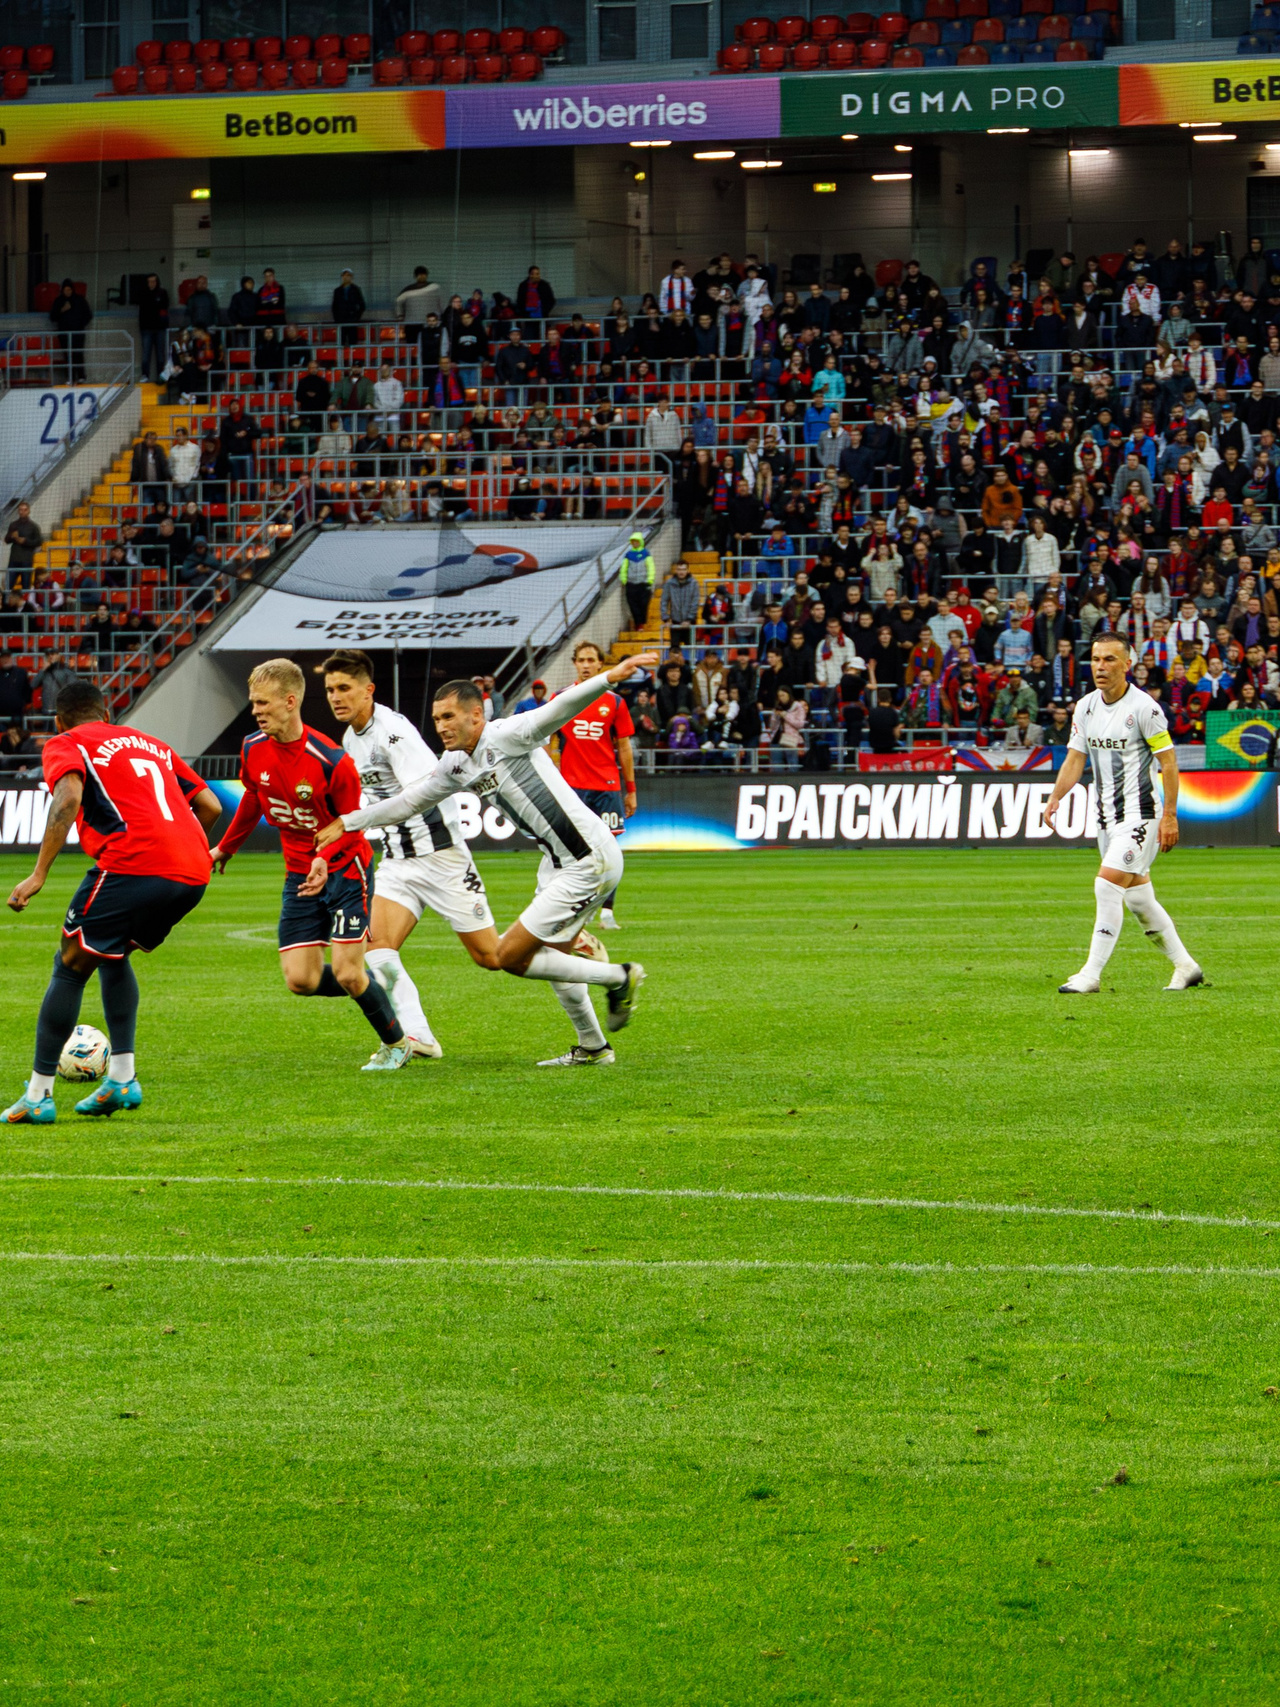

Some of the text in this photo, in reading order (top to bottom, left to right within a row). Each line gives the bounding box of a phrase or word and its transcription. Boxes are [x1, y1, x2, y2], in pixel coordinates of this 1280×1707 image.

[513, 94, 707, 131] wildberries
[841, 87, 1065, 116] DIGMA PRO
[225, 111, 358, 138] BetBoom
[39, 391, 98, 444] 213
[295, 616, 520, 632] Братский
[335, 610, 501, 620] BetBoom
[1087, 737, 1128, 750] MAXBET
[129, 758, 174, 821] 7
[735, 775, 963, 840] БРАТСКИЙ
